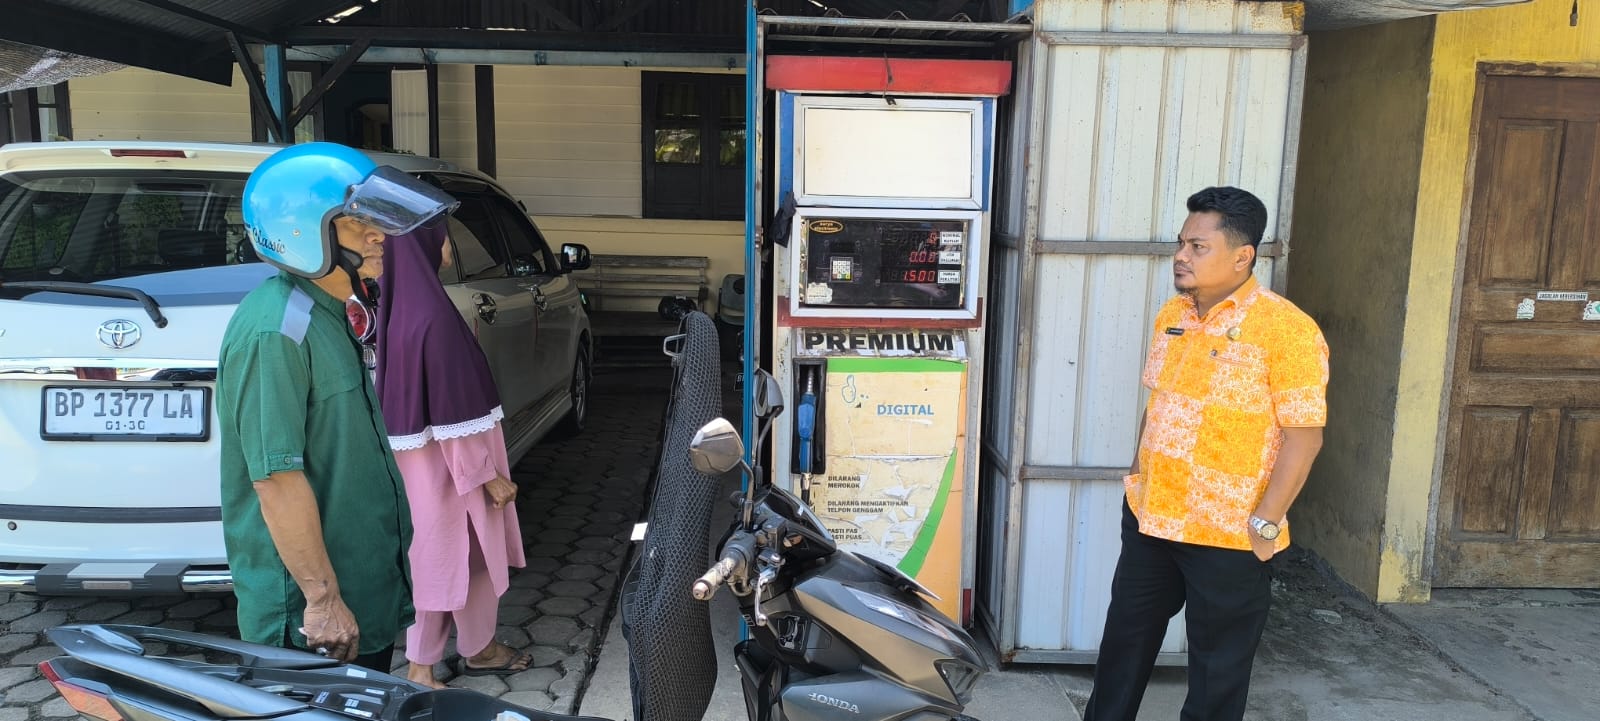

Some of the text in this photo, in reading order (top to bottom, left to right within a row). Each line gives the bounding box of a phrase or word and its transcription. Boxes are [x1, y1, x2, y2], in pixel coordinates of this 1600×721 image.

[253, 227, 285, 254] Classic
[805, 333, 954, 353] PREMIUM
[55, 391, 194, 419] BP 1377 LA
[877, 404, 935, 415] DIGITAL
[808, 692, 860, 714] HONDA
